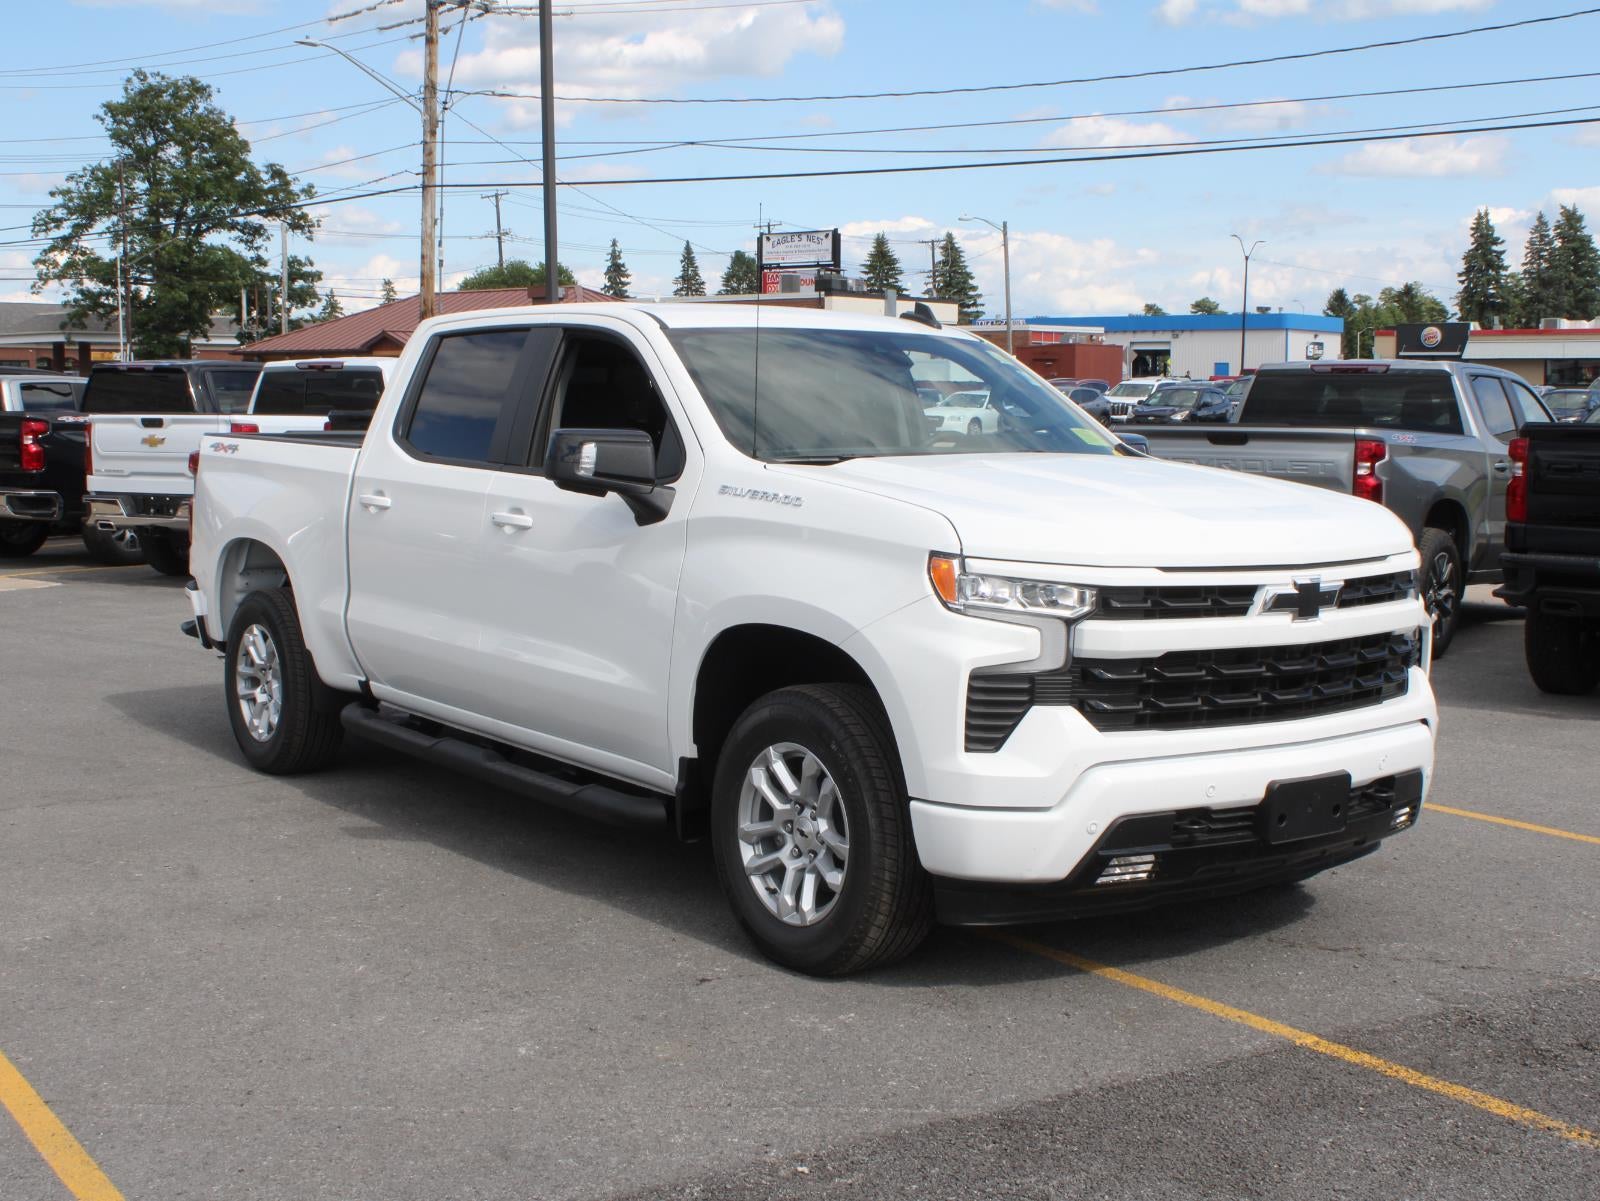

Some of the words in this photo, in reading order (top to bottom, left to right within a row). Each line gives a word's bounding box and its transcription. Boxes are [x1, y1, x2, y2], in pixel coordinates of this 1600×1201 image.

[771, 234, 803, 249] EAGLE'S
[806, 235, 824, 246] NEST
[719, 484, 803, 507] SILVERADO
